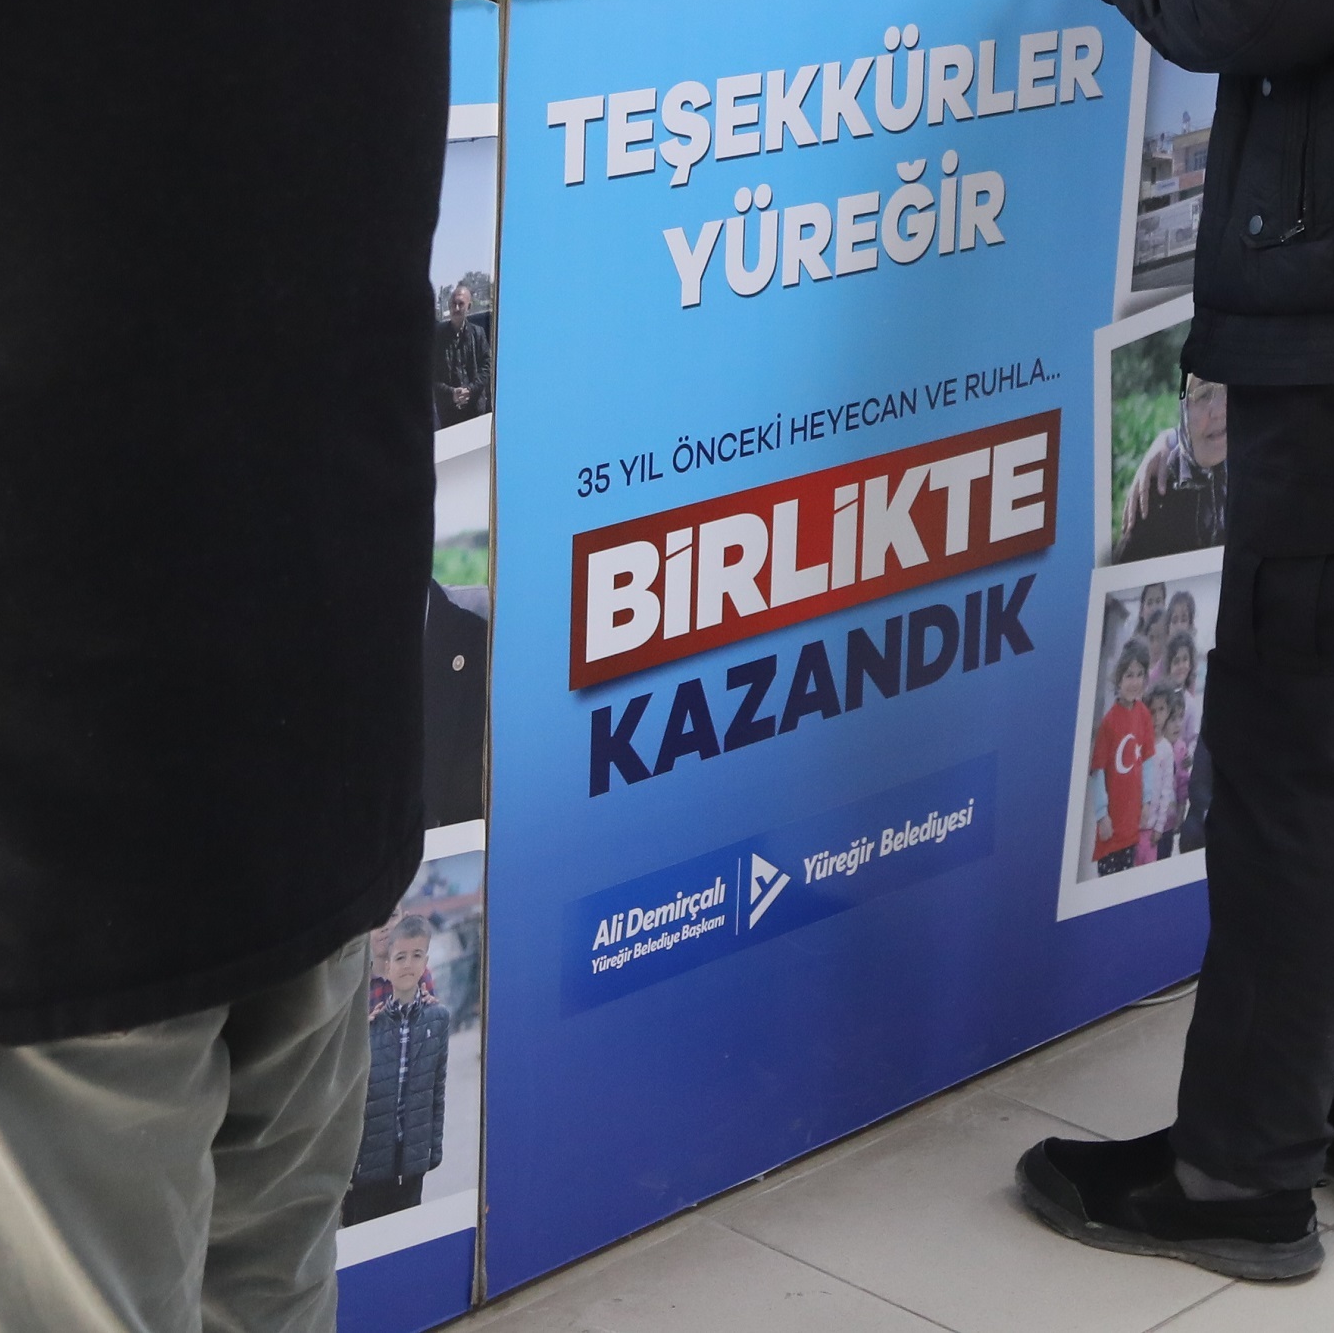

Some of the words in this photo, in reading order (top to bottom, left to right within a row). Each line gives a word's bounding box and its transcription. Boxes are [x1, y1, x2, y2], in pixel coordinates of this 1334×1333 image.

[546, 23, 1105, 188] TEŞEKKÜRLER
[663, 149, 1007, 309] YÜREĞİR
[576, 464, 610, 499] 35
[619, 451, 664, 489] YIL
[671, 411, 784, 475] ÖNCEKİ
[790, 390, 918, 449] HEYECAN
[925, 378, 959, 411] VE
[964, 357, 1061, 404] RUHLA...
[585, 431, 1049, 665] BİRLİKTE
[588, 572, 1038, 799] KAZANDIK
[592, 906, 625, 951] Ali
[626, 876, 727, 938] Demirçalı
[803, 840, 876, 885] Yüreğir
[878, 798, 975, 858] Belediyesi
[591, 945, 633, 975] Yüreğir
[633, 929, 681, 961] Belediye
[681, 913, 726, 943] Başkanı
